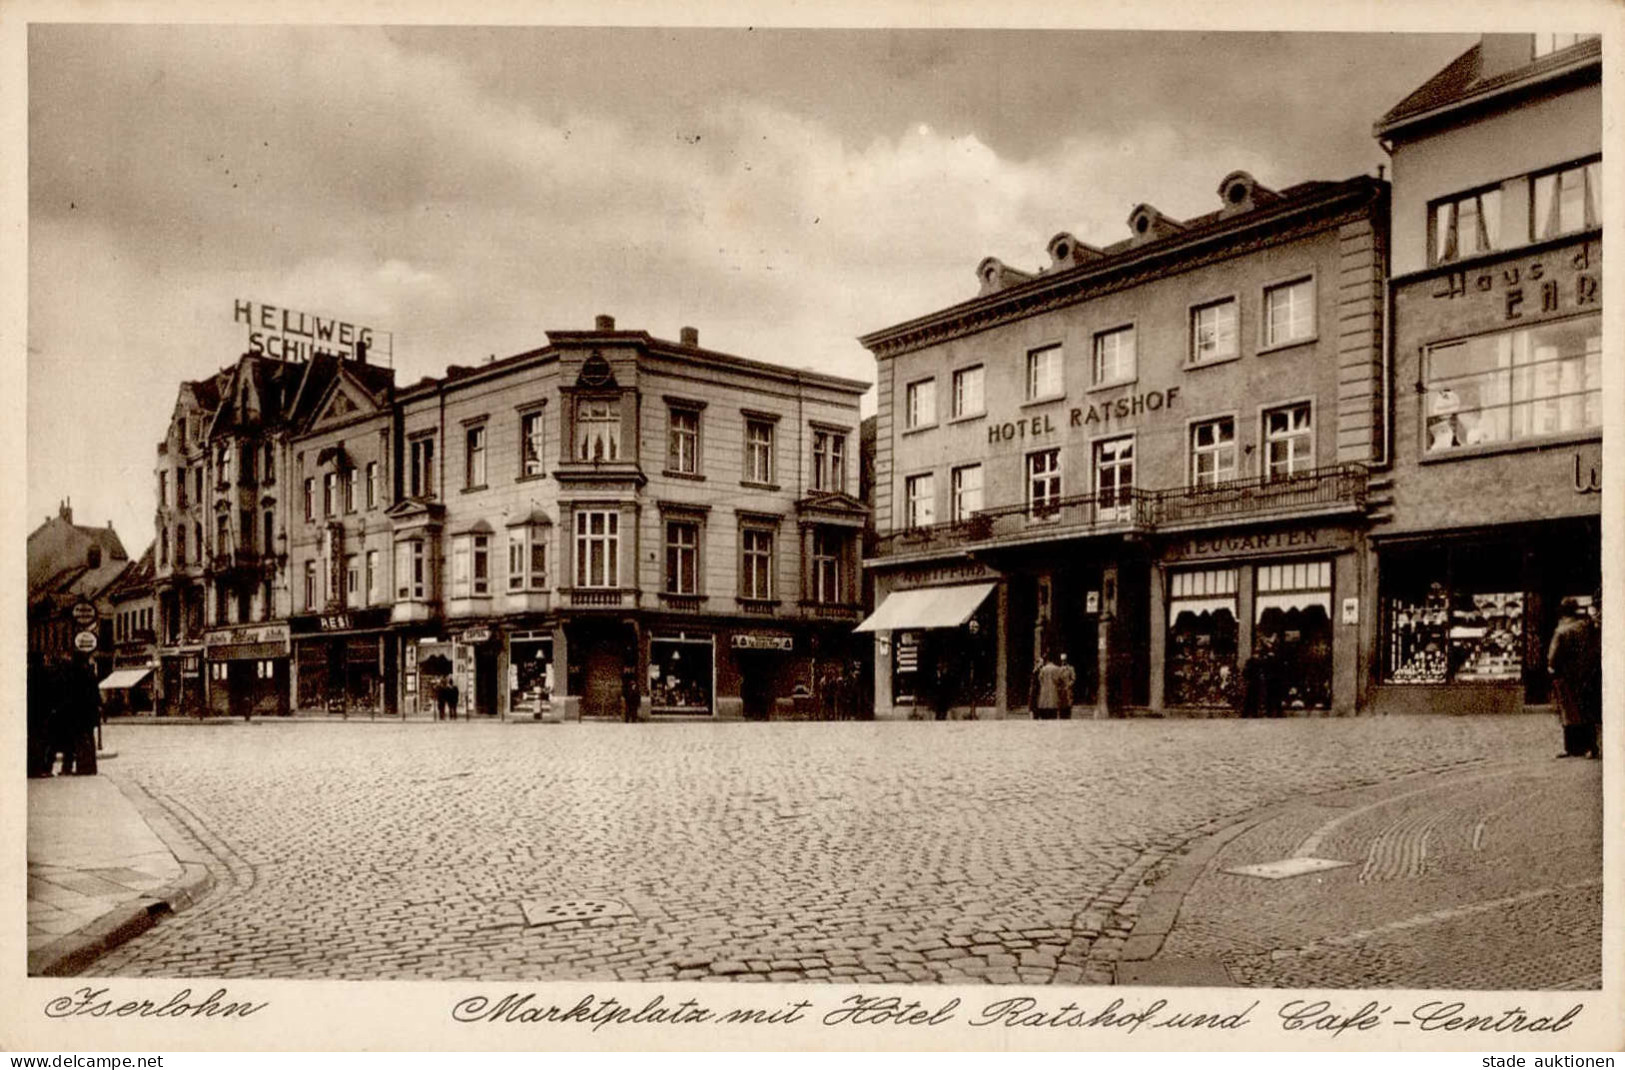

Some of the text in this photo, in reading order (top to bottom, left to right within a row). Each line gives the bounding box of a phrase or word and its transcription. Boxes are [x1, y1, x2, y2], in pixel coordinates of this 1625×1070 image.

[234, 298, 373, 350] HELLWEG
[248, 332, 351, 364] SCHU
[987, 386, 1181, 444] HOTEL RATSHOF
[1180, 529, 1318, 556] NEUGARTEN
